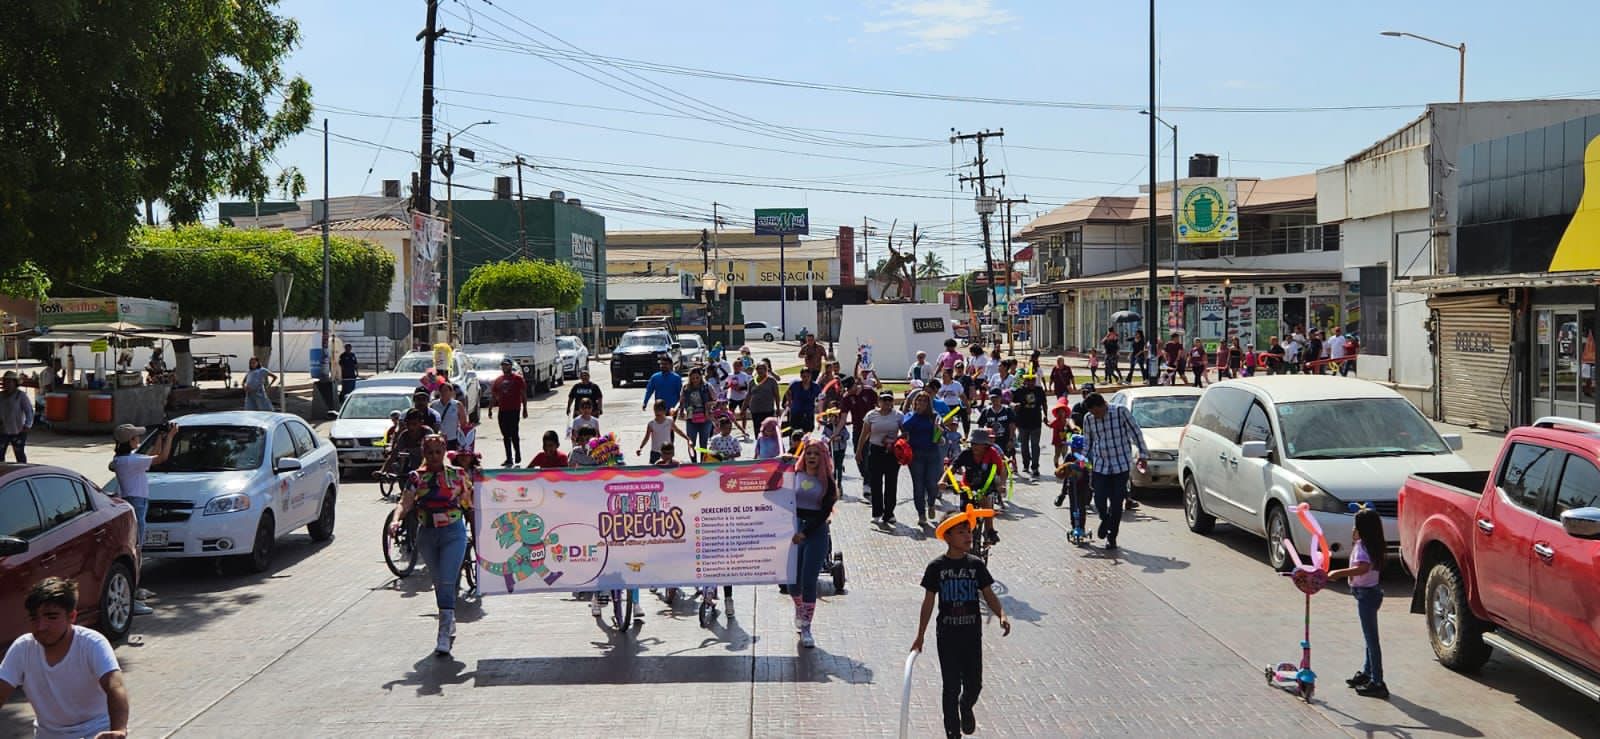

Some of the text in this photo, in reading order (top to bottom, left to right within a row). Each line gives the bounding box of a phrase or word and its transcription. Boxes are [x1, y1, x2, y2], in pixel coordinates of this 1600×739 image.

[701, 506, 731, 514] DERECHOS
[755, 504, 773, 512] NIÑOS
[599, 506, 685, 542] DERECHOS
[569, 546, 598, 558] DIF
